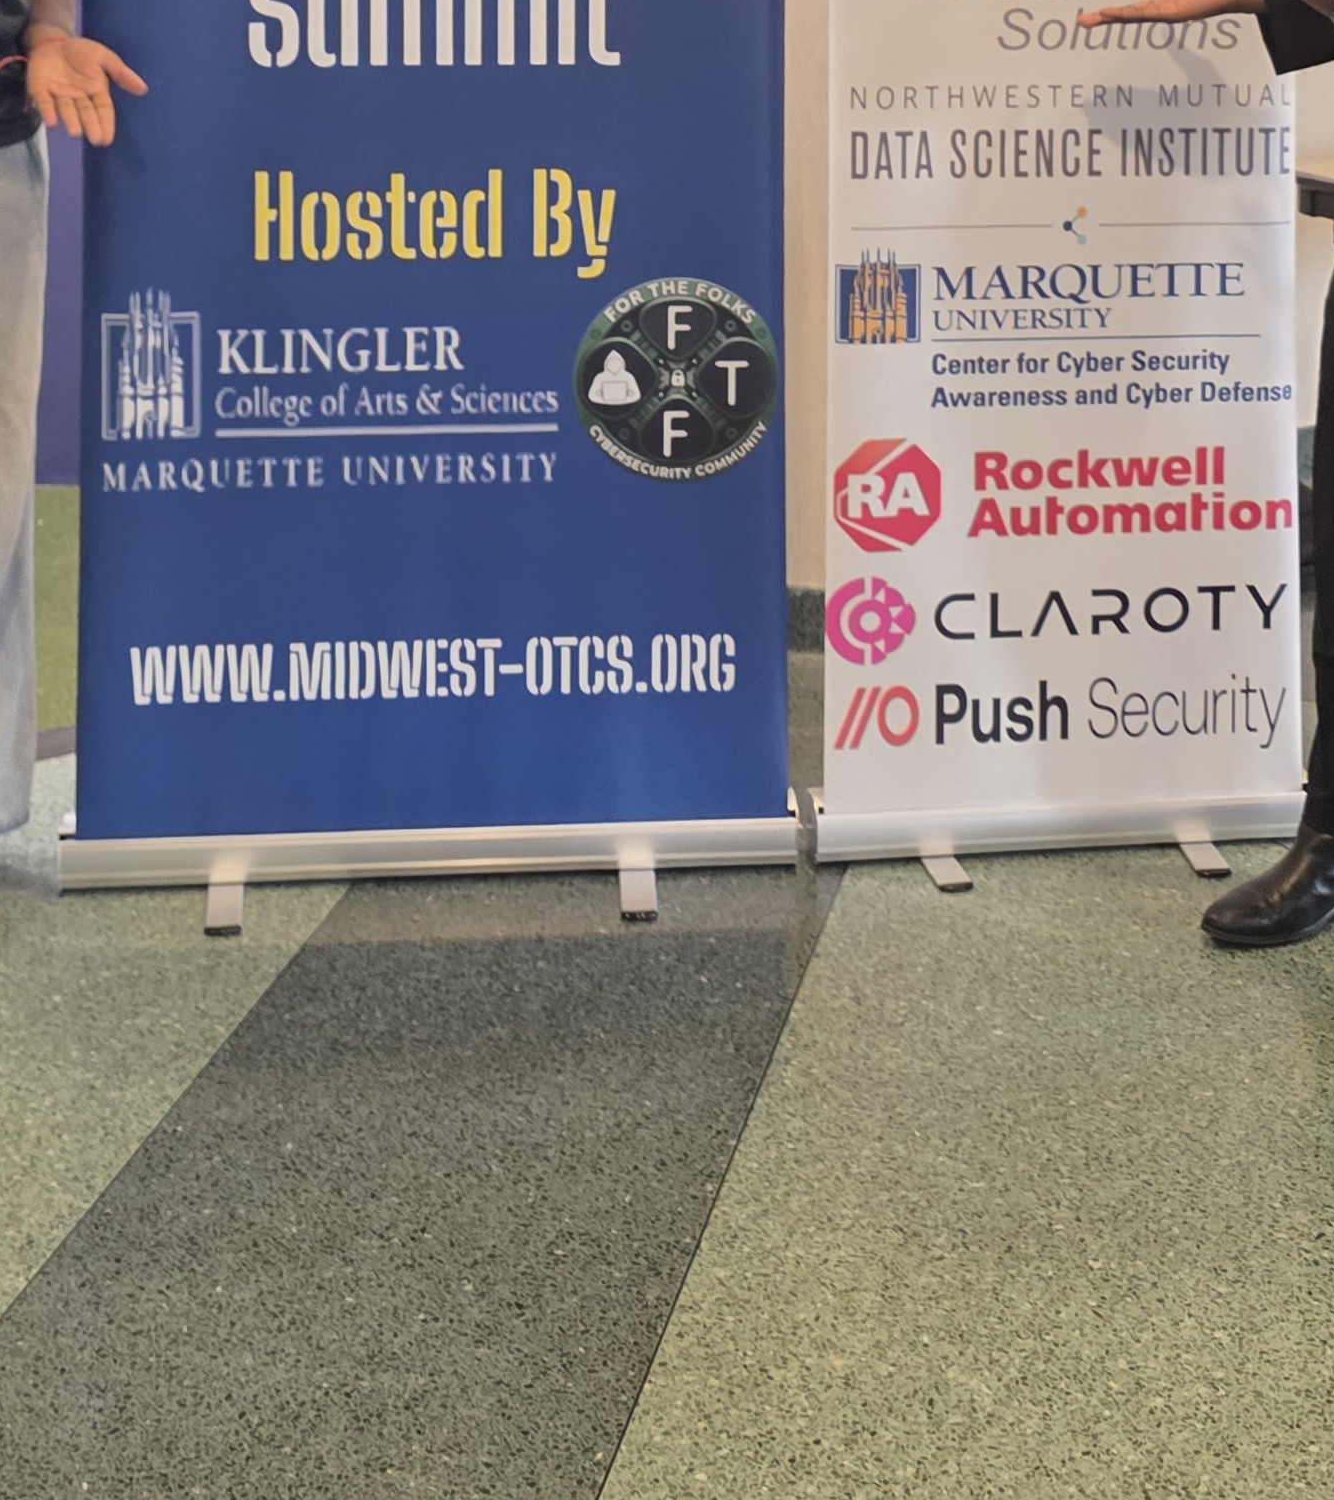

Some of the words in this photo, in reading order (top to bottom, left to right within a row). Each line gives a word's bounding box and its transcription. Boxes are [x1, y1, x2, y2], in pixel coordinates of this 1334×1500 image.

[997, 8, 1242, 52] Solutions
[849, 83, 1135, 110] NORTHWESTERN
[1158, 81, 1292, 108] MUTUAL
[850, 129, 935, 180] DATA
[950, 128, 1103, 179] SCIENCE
[1120, 125, 1292, 178] INSTITUTE
[253, 168, 503, 262] Hosted
[532, 167, 616, 279] By
[603, 289, 647, 324] FOR
[647, 280, 689, 299] THE
[695, 282, 758, 326] FOLKS
[932, 261, 1247, 305] MARQUETTE
[667, 304, 694, 351] F
[932, 306, 1113, 333] UNIVERSITY
[216, 325, 465, 376] KLINGLER
[931, 350, 1012, 376] Center
[1016, 350, 1051, 375] for
[1056, 349, 1125, 380] Cyber
[1130, 347, 1231, 377] Security
[214, 386, 314, 428] College
[321, 384, 349, 417] of
[354, 384, 409, 417] Arts
[416, 385, 444, 416] &
[449, 383, 560, 417] Sciences
[714, 360, 750, 407] T
[930, 385, 1070, 410] Awareness
[1074, 383, 1120, 406] and
[1125, 381, 1195, 410] Cyber
[1200, 380, 1293, 404] Defense
[589, 424, 692, 480] CYBERSECURITY
[694, 420, 769, 478] COMMUNITY
[662, 410, 690, 458] F
[102, 456, 326, 494] MARQUETTE
[342, 451, 559, 487] UNIVERSITY
[973, 445, 1227, 491] Rockwell
[845, 470, 931, 520] RA
[967, 491, 1294, 539] Automation
[933, 583, 1289, 641] CLAROTY
[129, 632, 737, 706] WWW.MIDWEST-OTCS.ORG
[934, 679, 1070, 746] Push
[1087, 673, 1288, 749] Security
